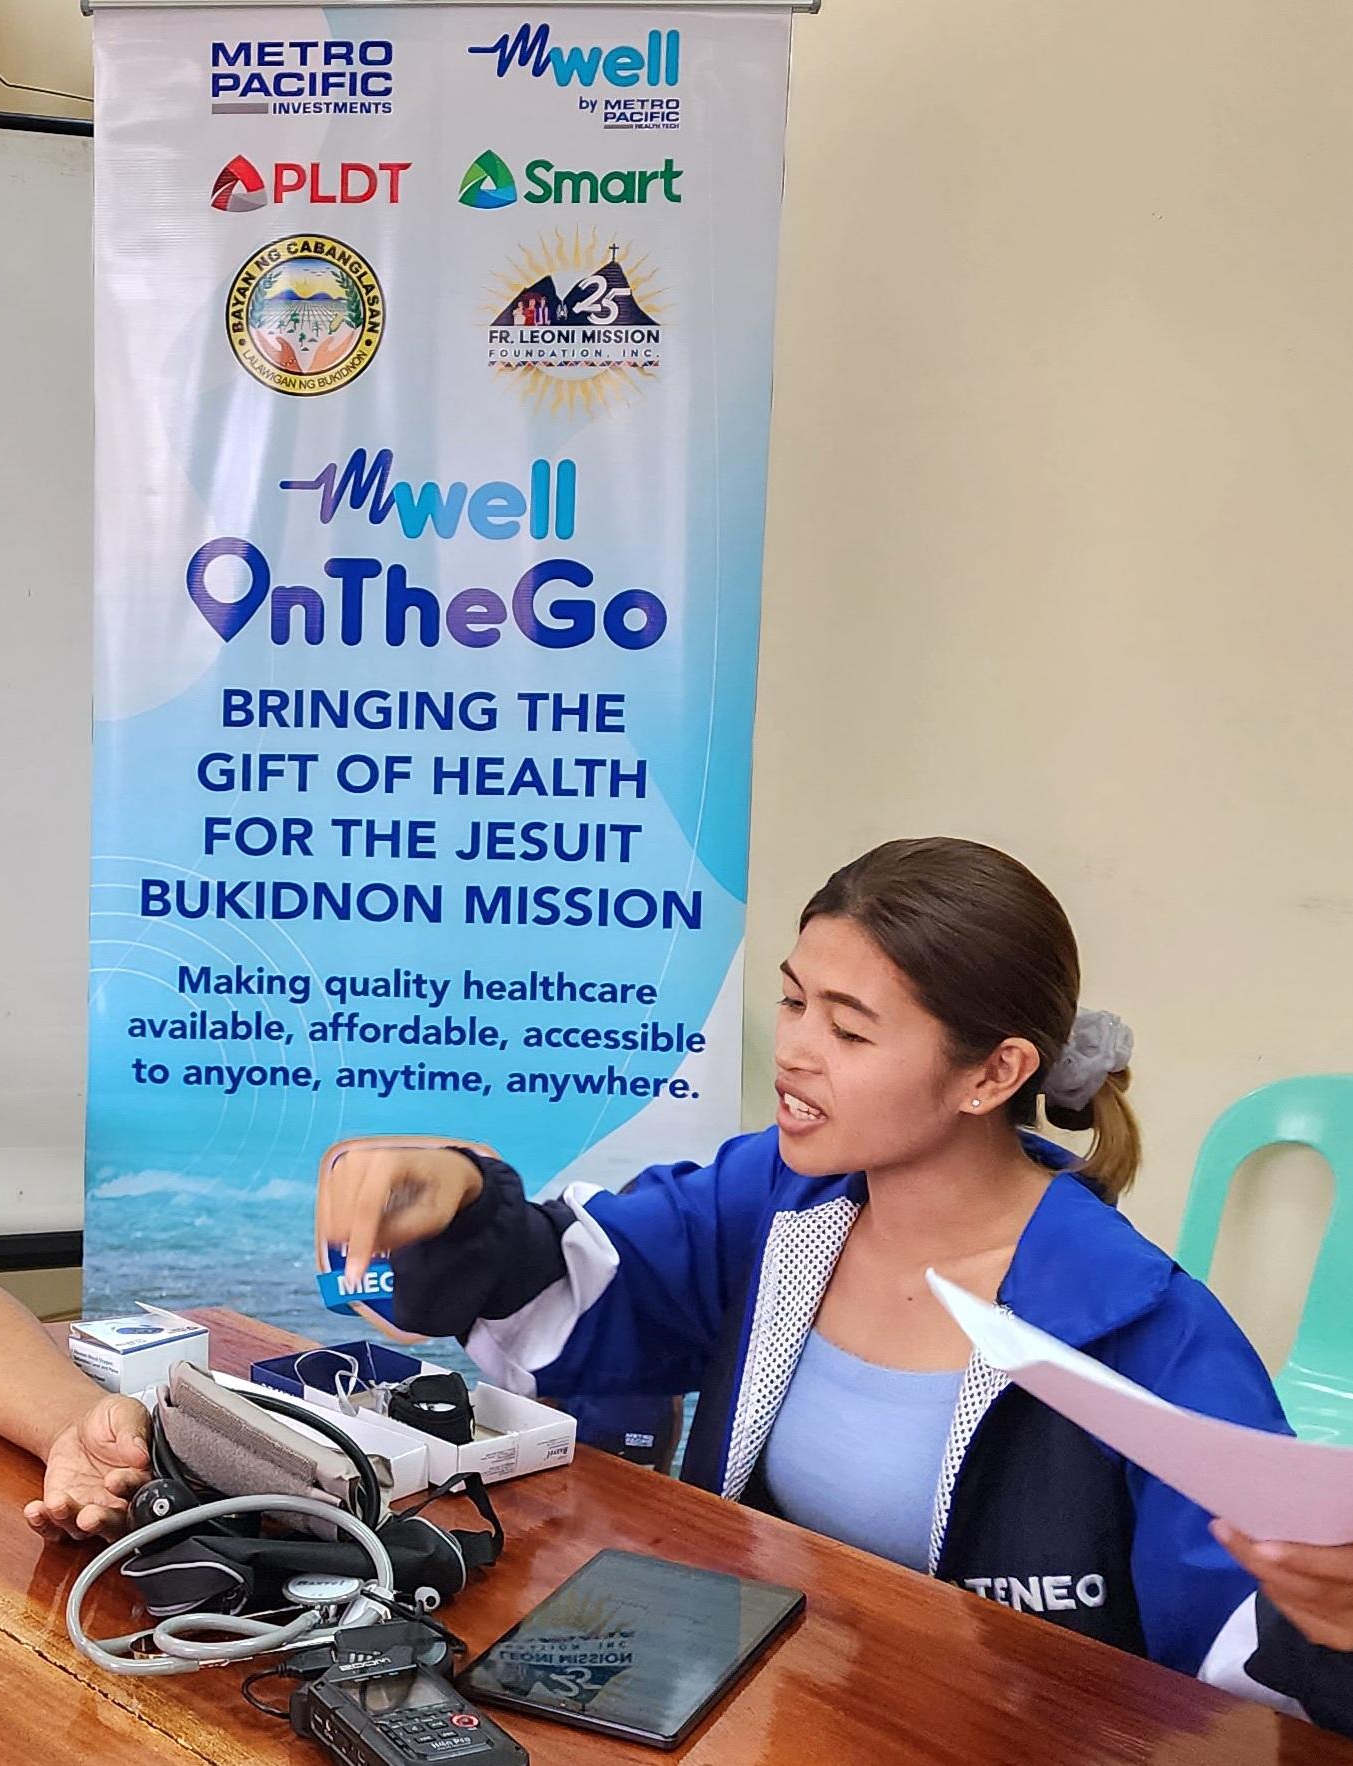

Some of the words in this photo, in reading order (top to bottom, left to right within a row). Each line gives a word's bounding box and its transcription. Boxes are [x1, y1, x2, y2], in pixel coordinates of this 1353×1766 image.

[212, 41, 393, 66] METRO
[468, 23, 680, 87] Mwell
[212, 72, 393, 97] PACIFIC
[579, 96, 597, 113] by
[604, 99, 679, 109] METRO
[273, 102, 392, 114] INVESTMENTS
[604, 112, 679, 122] PACIFIC
[274, 162, 413, 204] PLDT
[524, 158, 683, 205] Smart
[231, 271, 256, 333] BAYAN
[254, 250, 281, 271] NG
[287, 240, 381, 333] CABANGLASAN
[572, 275, 631, 324] 25
[489, 330, 514, 343] FR.
[520, 330, 575, 343] LEONI
[582, 330, 659, 343] MISSION
[623, 350, 660, 358] INC.
[243, 350, 297, 389] LALAWIGAN
[299, 378, 315, 389] NG
[318, 350, 367, 387] BUKIDNON
[279, 447, 576, 540] Mwell
[186, 536, 667, 651] OnTheGo
[222, 688, 497, 731] BRINGING
[517, 692, 626, 733] THE
[197, 752, 319, 793] GIFT
[336, 754, 412, 794] OF
[433, 756, 647, 799] HEALTH
[204, 816, 315, 856] FOR
[332, 817, 436, 859] THE
[455, 820, 643, 863] JESUIT
[140, 878, 444, 924] BUKIDNON
[463, 885, 703, 931] MISSION
[177, 966, 312, 1004] Making
[324, 970, 451, 1008] quality
[462, 972, 659, 1005] healthcare
[127, 1010, 295, 1048] available,
[308, 1013, 509, 1053] affordable,
[523, 1022, 707, 1053] accessible
[132, 1059, 170, 1086] to
[182, 1061, 322, 1096] anyone,
[335, 1062, 493, 1098] anytime,
[507, 1070, 700, 1101] anywhere.
[950, 1574, 1108, 1612] TENEO
